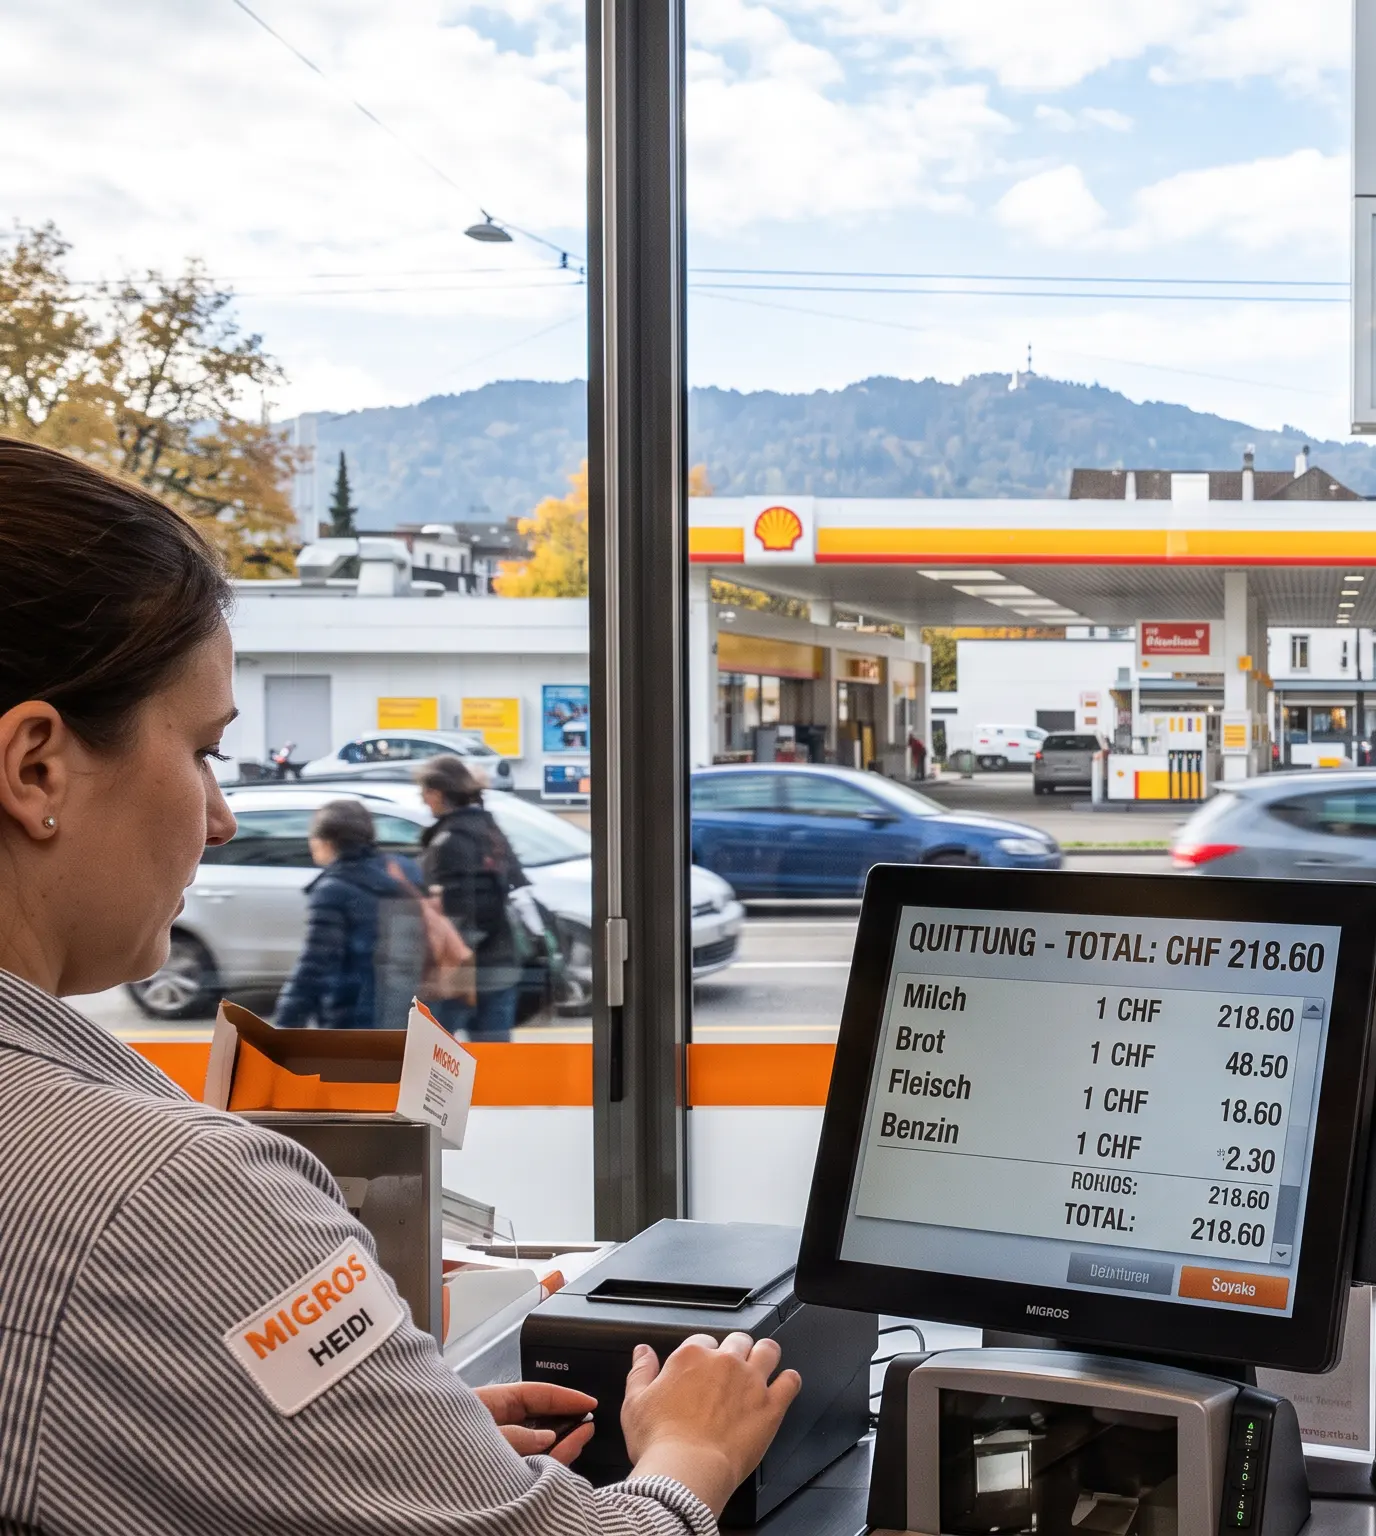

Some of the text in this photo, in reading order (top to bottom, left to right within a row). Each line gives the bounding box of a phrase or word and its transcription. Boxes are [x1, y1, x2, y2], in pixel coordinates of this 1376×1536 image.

[908, 921, 1037, 957] QUITTUNG
[1064, 930, 1157, 965] TOTAL:
[1165, 935, 1222, 967] CHF
[1227, 939, 1326, 974] 218.60
[902, 982, 1295, 1033] Milch 1 CHF 218.60
[433, 1043, 460, 1078] MIGROS
[895, 1026, 1289, 1080] Brot 1 CHF 48.50
[888, 1069, 1283, 1127] Fleisch 1 CHF 18.60
[880, 1112, 960, 1145] Benzin
[1077, 1131, 1087, 1155] 1
[1096, 1133, 1142, 1160] CHF
[1208, 1185, 1270, 1210] 218.60
[1064, 1202, 1266, 1248] TOTAL: 218.60
[244, 1253, 368, 1360] MIGROS
[1026, 1304, 1070, 1320] MIGROS
[308, 1308, 374, 1367] HEIDI
